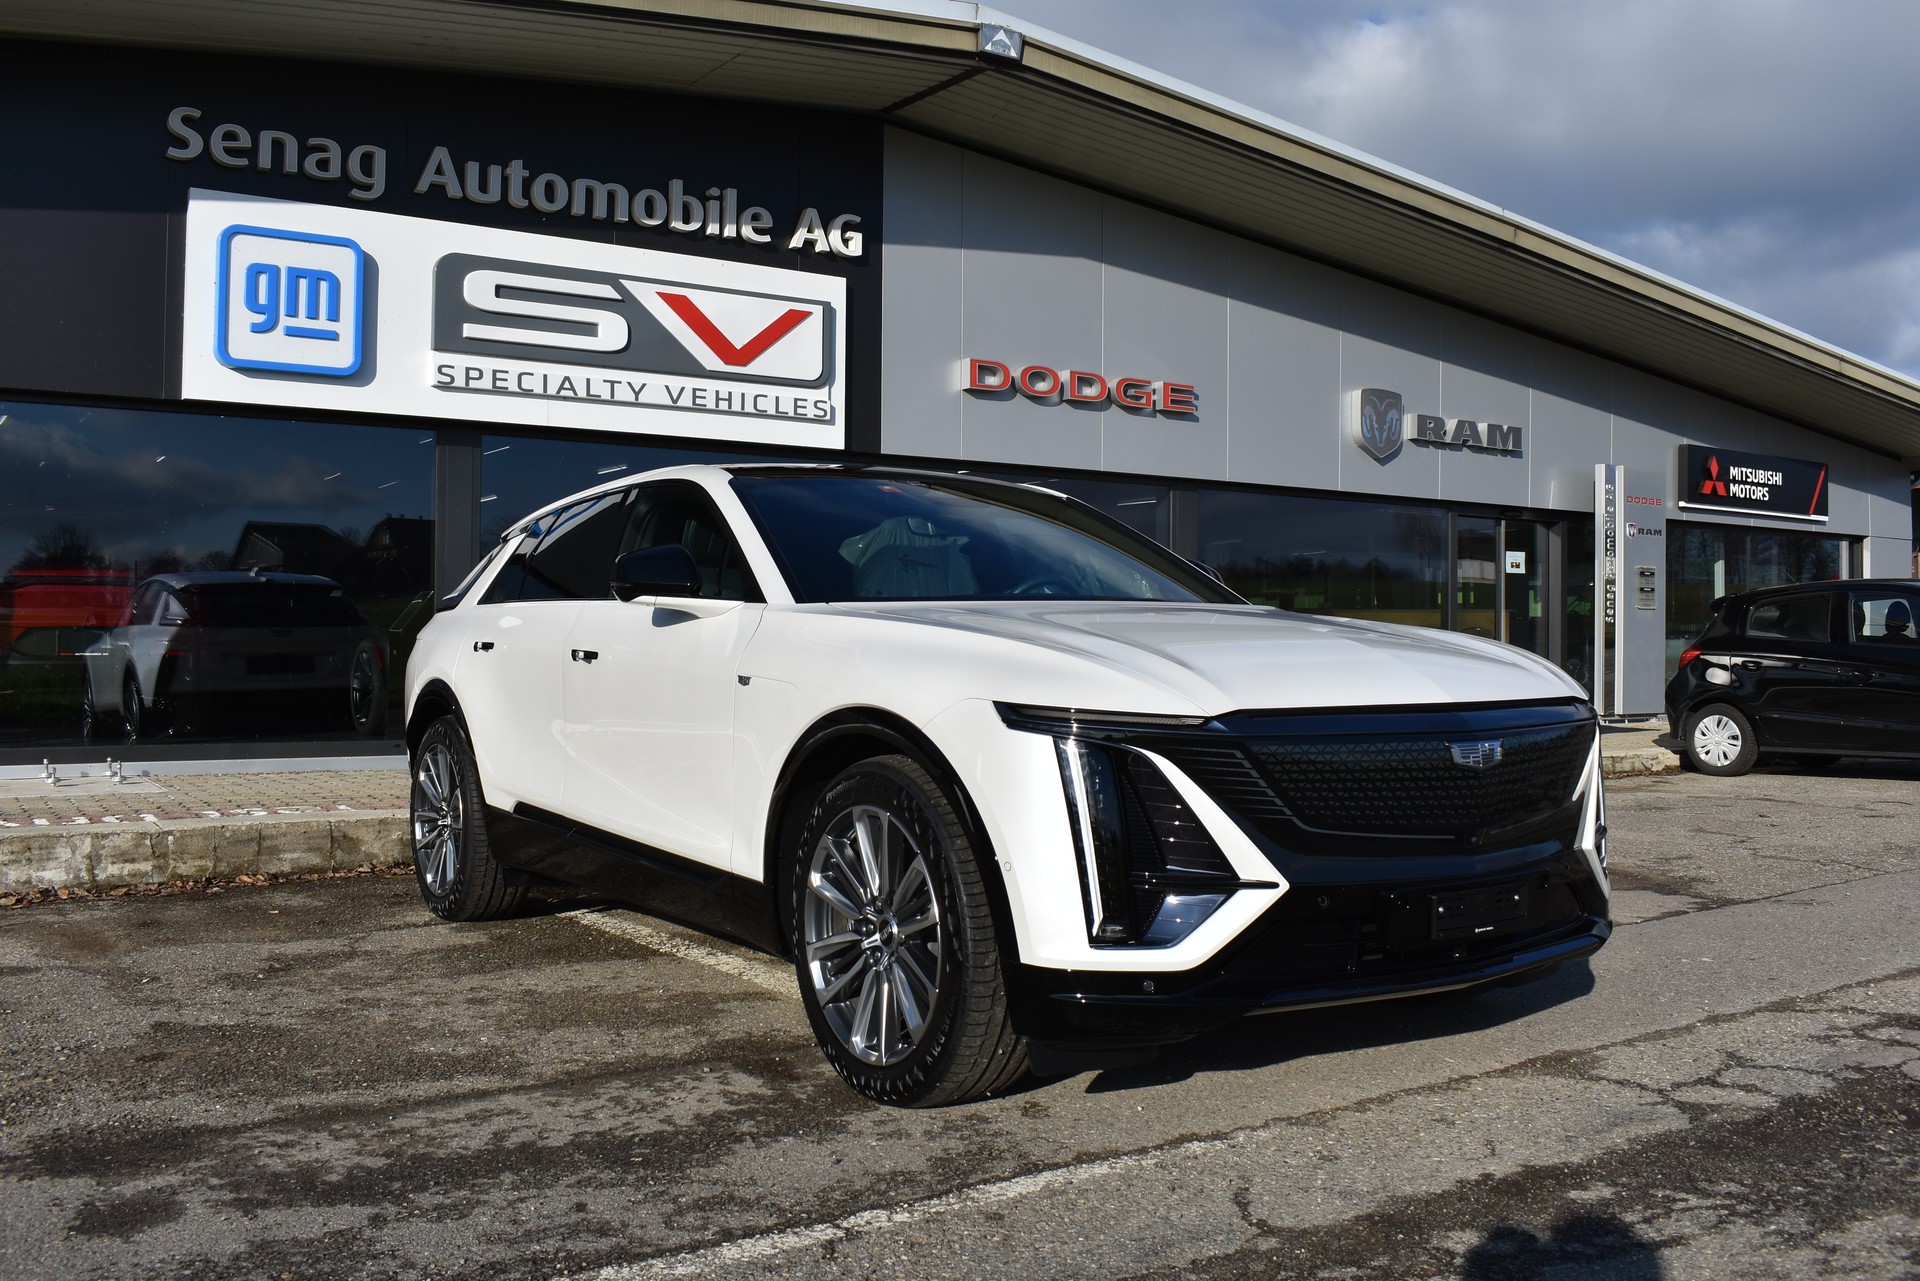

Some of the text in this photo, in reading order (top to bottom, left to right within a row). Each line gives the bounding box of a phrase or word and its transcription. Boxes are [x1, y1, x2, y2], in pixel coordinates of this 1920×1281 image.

[165, 106, 864, 258] Senag Automobile AG
[244, 262, 341, 335] gm
[463, 270, 814, 365] SV
[436, 364, 828, 419] SPECIALTY VEHICLES
[968, 358, 1198, 413] DODGE
[1416, 413, 1523, 452] RAM
[1730, 466, 1782, 486] MITSUBISHI
[1730, 483, 1769, 501] MOTORS
[1626, 496, 1662, 506] DODGE
[1637, 528, 1662, 536] RAM
